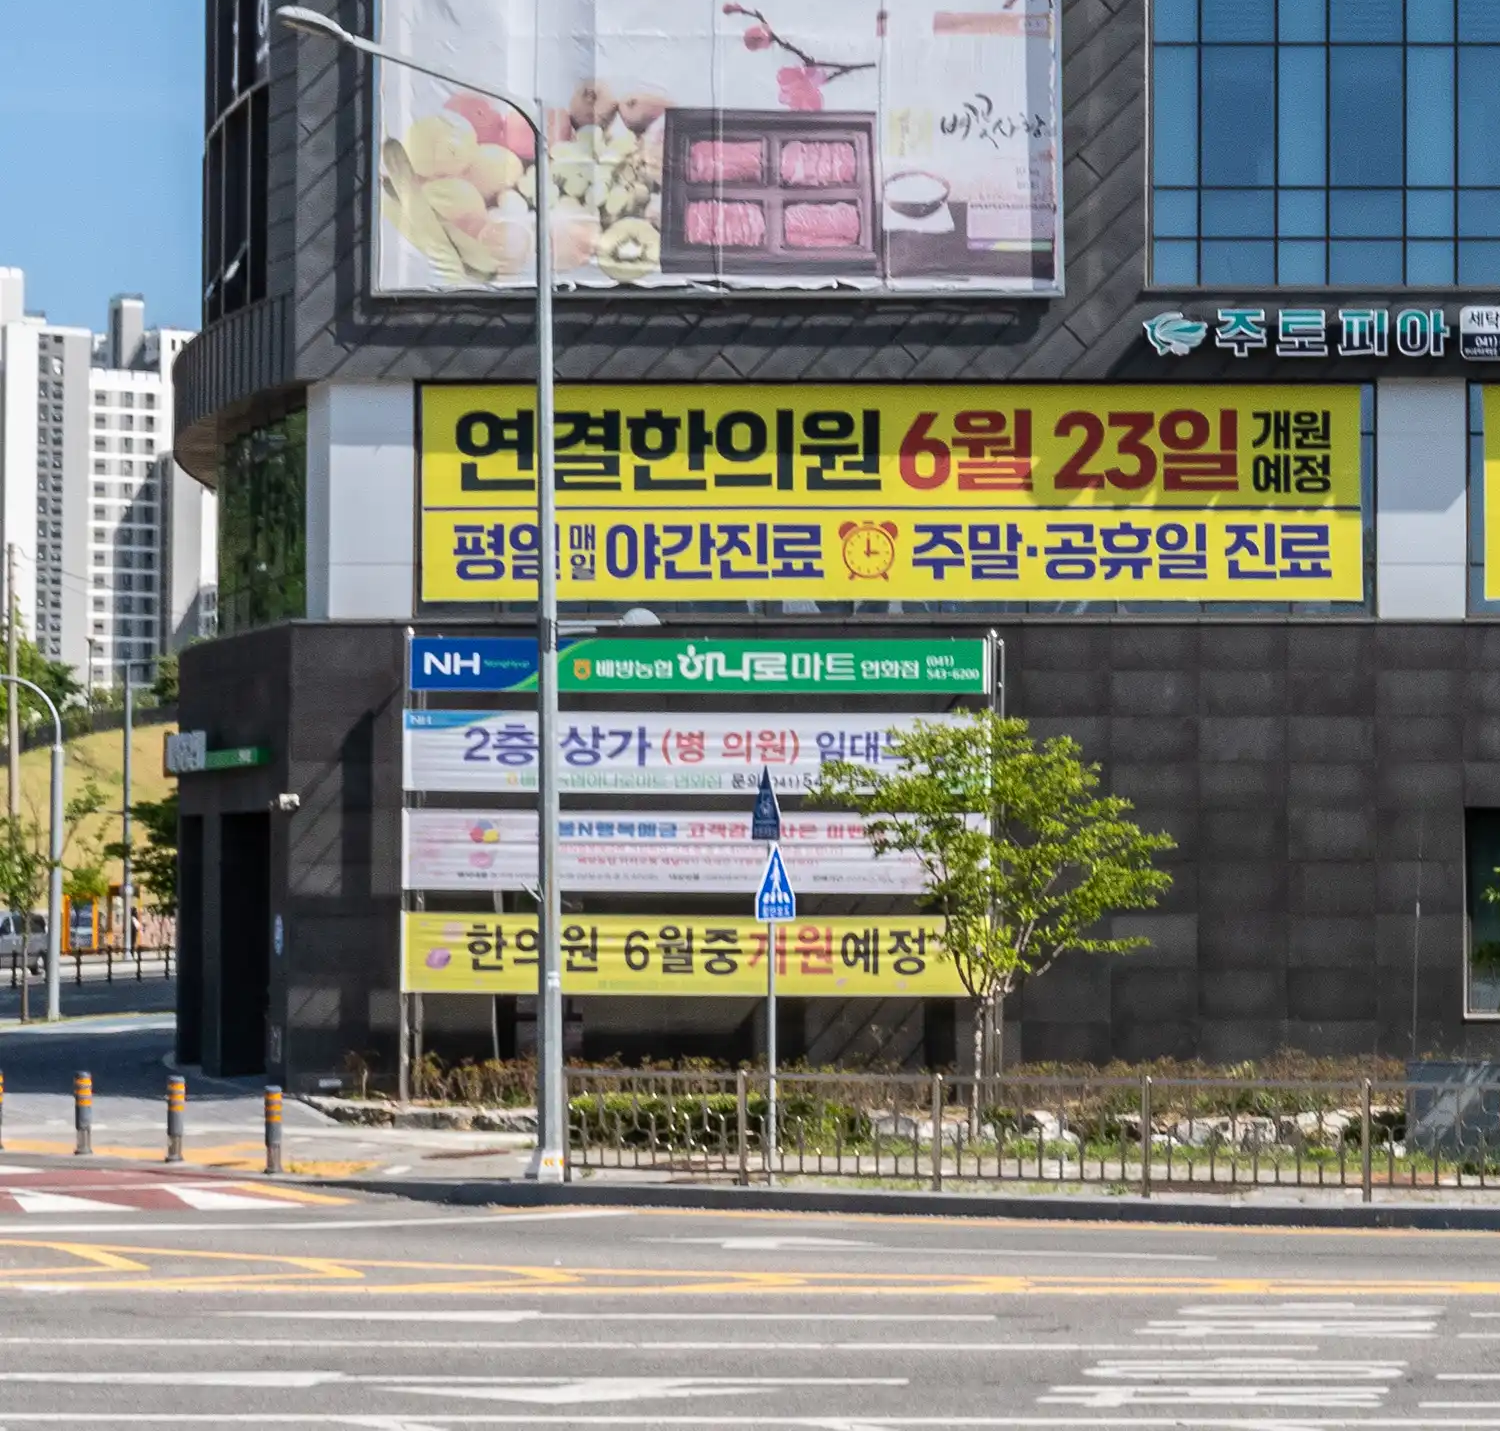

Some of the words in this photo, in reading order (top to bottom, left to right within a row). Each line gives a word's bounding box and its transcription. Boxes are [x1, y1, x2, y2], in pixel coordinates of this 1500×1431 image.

[1215, 308, 1450, 357] 주토피아
[455, 409, 882, 491] 연결한의원
[899, 409, 1033, 491] 6월
[1053, 409, 1239, 491] 23일
[1251, 410, 1332, 450] 개원
[1252, 454, 1332, 493] 예정
[453, 523, 560, 580] 평일
[605, 523, 824, 580] 야간진료
[1225, 522, 1333, 580] 진료
[424, 652, 480, 675] NH
[596, 659, 673, 679] 배방농협
[677, 644, 856, 682] 하나로마트
[410, 714, 432, 725] NH
[464, 724, 539, 766] 2층
[559, 725, 652, 767] 상가
[662, 728, 705, 765] (병
[722, 729, 799, 764] 의원)
